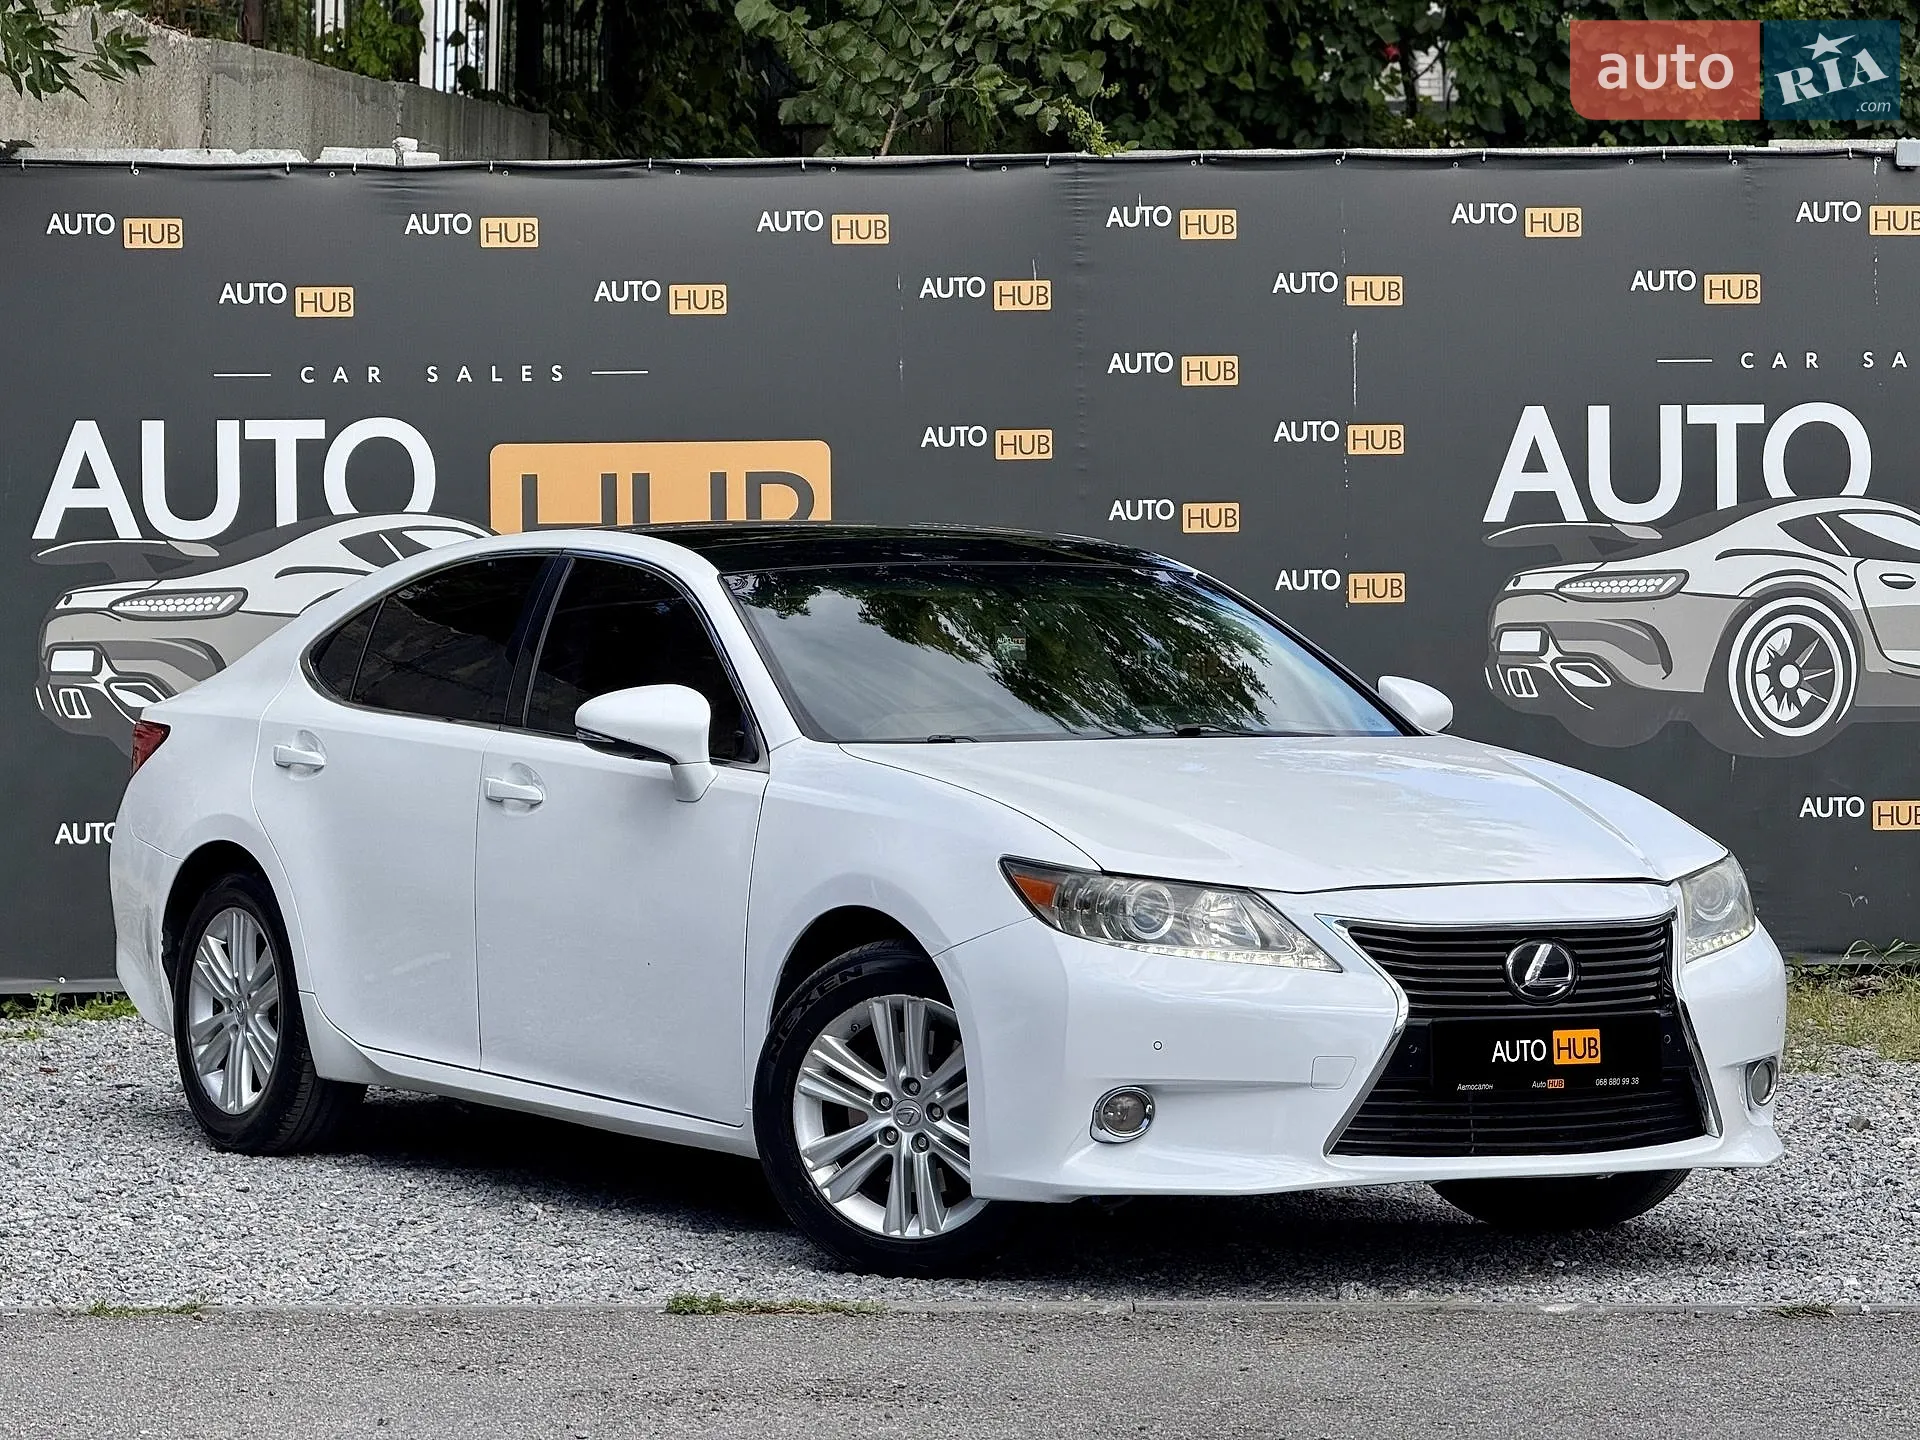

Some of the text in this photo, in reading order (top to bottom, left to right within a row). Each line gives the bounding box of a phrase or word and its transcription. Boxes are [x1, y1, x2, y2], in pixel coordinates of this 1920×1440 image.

[757, 210, 887, 240] AUTO HUB
[1106, 206, 1235, 235] AUTO HUB
[1451, 203, 1579, 233] AUTO HUB
[1796, 201, 1862, 222] AUTO
[47, 213, 181, 244] AUTO HUB
[405, 213, 536, 244] AUTO HUB
[219, 283, 351, 313] AUTO HUB
[594, 280, 725, 311] AUTO HUB
[920, 277, 1049, 306] AUTO HUB
[1273, 272, 1400, 301] AUTO HUB
[1631, 270, 1759, 300] AUTO HUB
[300, 364, 563, 384] CAR SALES
[1108, 352, 1236, 382] AUTO HUB
[1740, 352, 1819, 369] CAR
[921, 426, 1051, 456] AUTO HUB
[1274, 421, 1402, 451] AUTO HUB
[1482, 402, 1873, 523] AUTO
[32, 417, 437, 540] AUTO
[1109, 499, 1238, 529] AUTO HUB
[1275, 569, 1403, 599] AUTO HUB
[1800, 796, 1865, 818] AUTO
[767, 963, 863, 1054] NEXEN
[1491, 1036, 1599, 1063] AUTO HUB
[1531, 1079, 1564, 1089] Auto HUB
